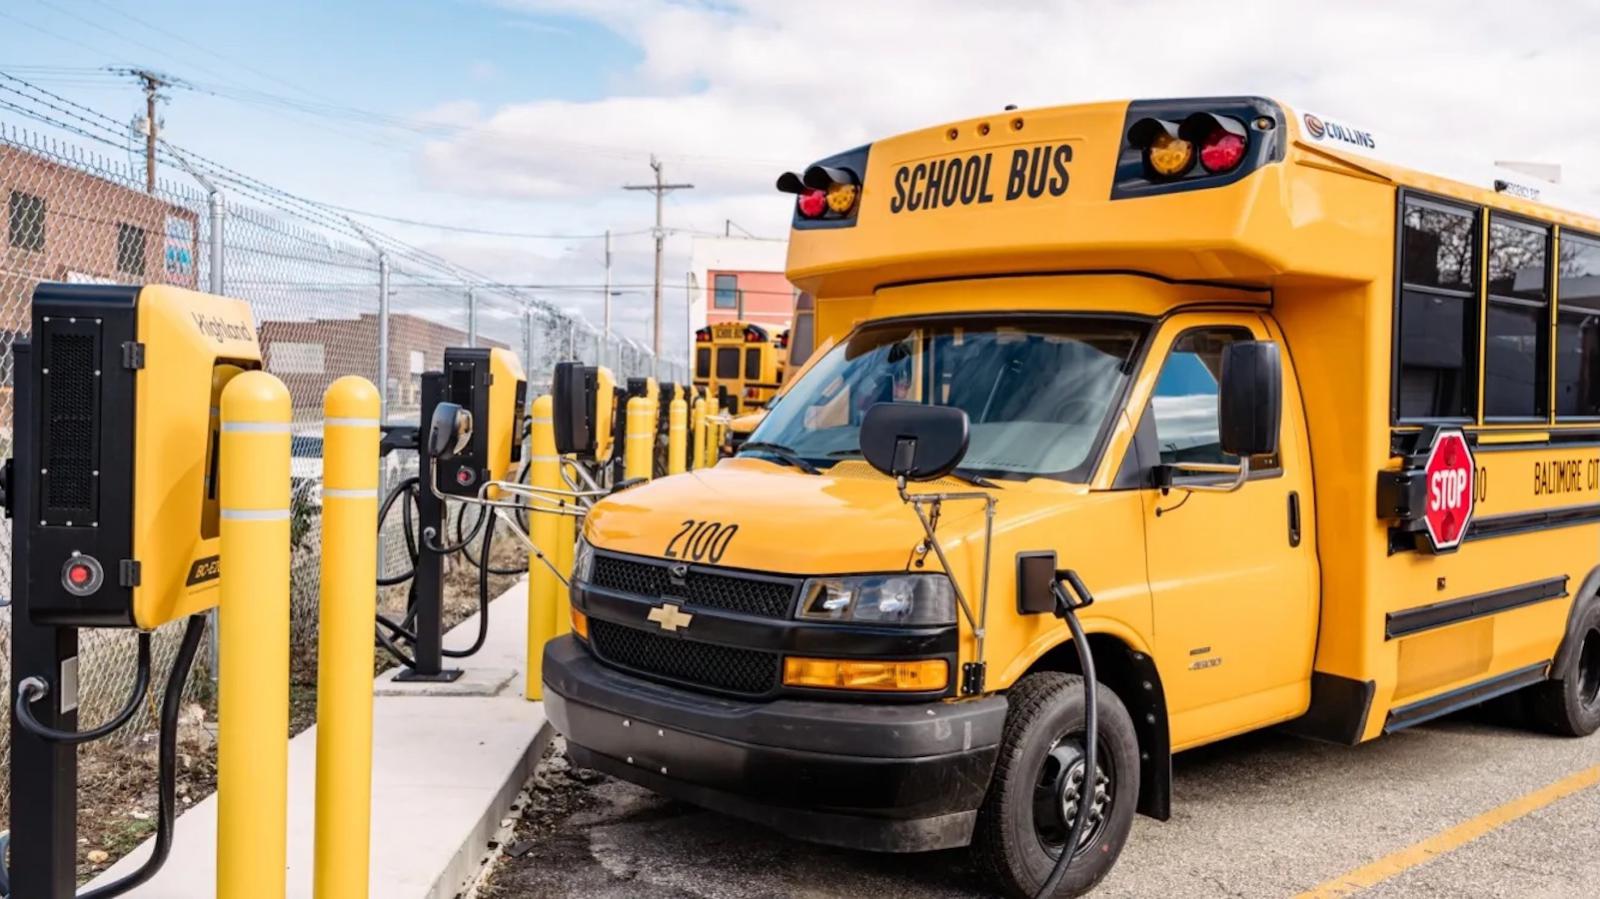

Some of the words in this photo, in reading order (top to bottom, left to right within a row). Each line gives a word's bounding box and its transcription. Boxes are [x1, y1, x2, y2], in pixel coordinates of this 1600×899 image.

[1324, 121, 1376, 149] COLLINS
[890, 152, 994, 214] SCHOOL
[1005, 144, 1073, 201] BUS
[191, 311, 253, 343] Highland
[1431, 467, 1467, 511] STOP
[1534, 460, 1582, 495] BALTIMORE
[664, 519, 739, 563] 2100
